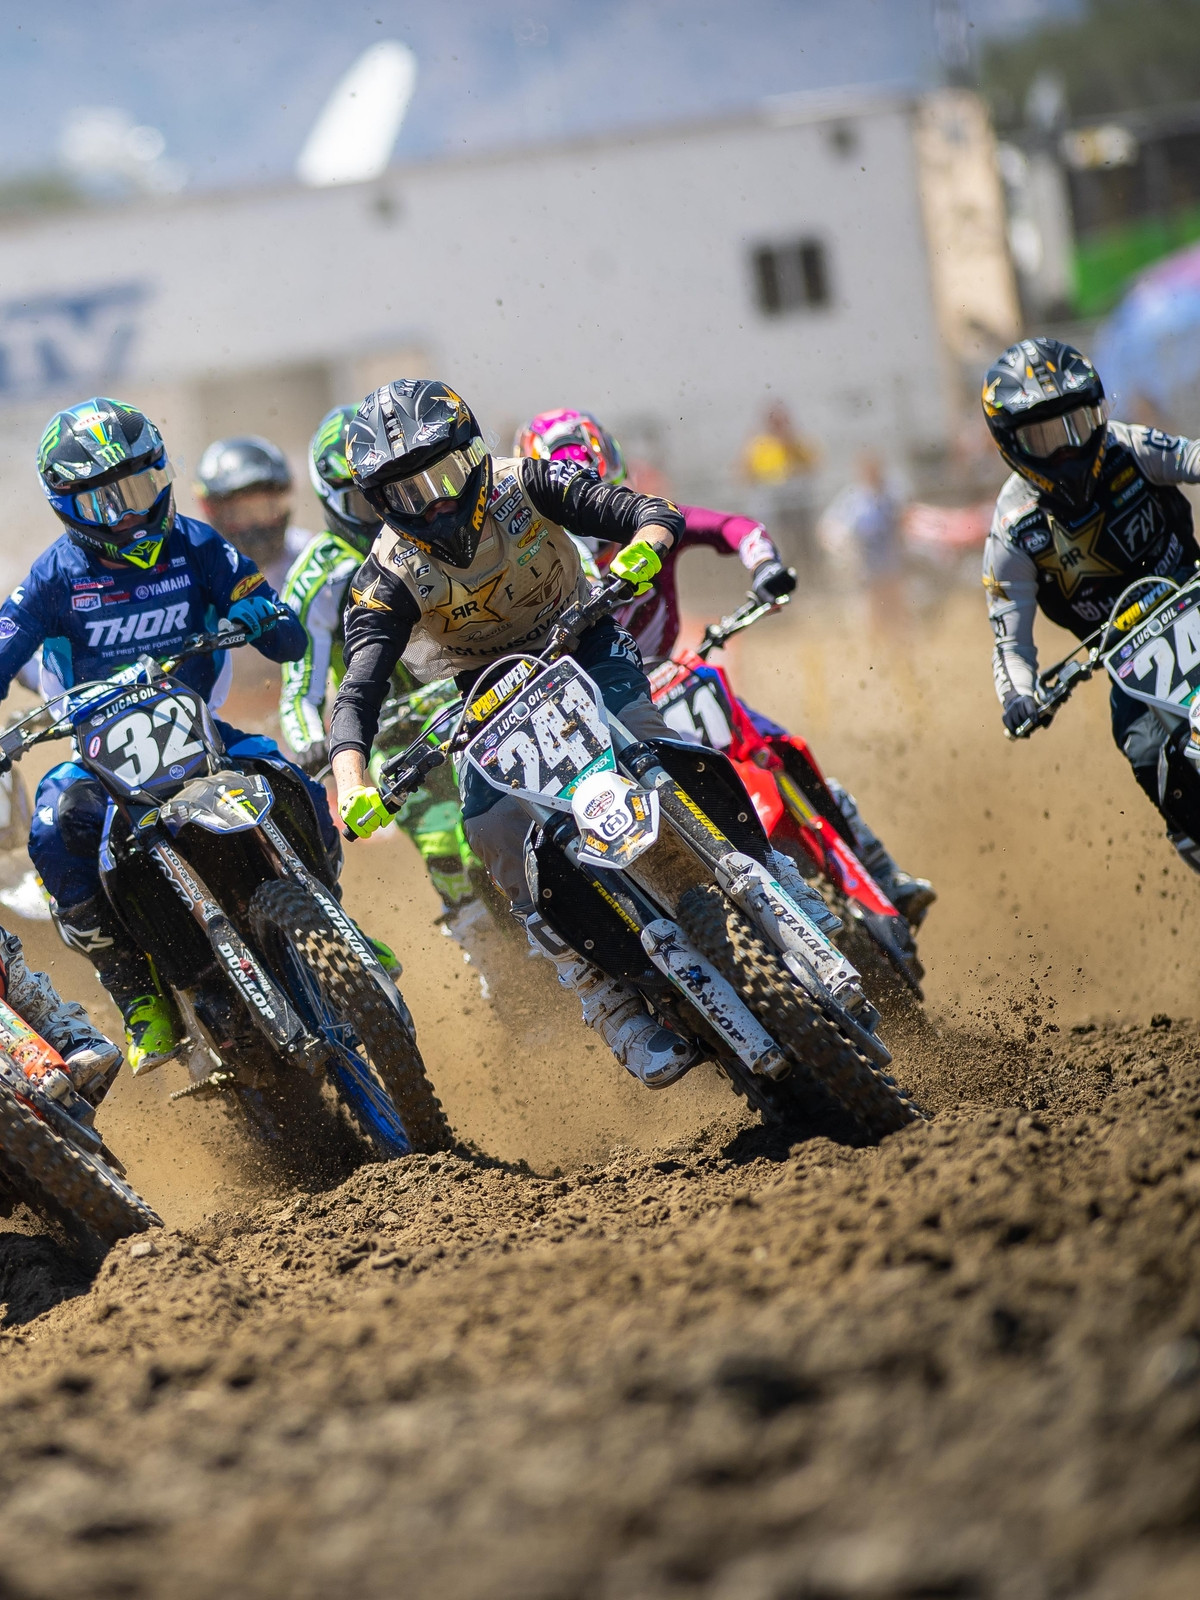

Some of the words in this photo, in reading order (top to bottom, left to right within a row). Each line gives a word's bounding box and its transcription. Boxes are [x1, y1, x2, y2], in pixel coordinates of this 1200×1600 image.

[494, 489, 523, 521] WPS
[1124, 502, 1155, 553] FLY
[75, 597, 98, 608] 100%
[148, 574, 191, 596] YAMAHA
[85, 601, 190, 647] THOR
[219, 633, 246, 646] ARC
[1161, 609, 1178, 625] OIL
[102, 651, 115, 659] THE
[116, 648, 136, 656] FIRST
[138, 645, 152, 653] THE
[152, 637, 183, 650] FOREVER
[106, 692, 140, 719] LUCAS
[139, 687, 159, 700] OIL
[471, 662, 529, 721] PROTAPER
[527, 688, 545, 706] OIL
[107, 695, 204, 788] 32
[497, 678, 610, 793] 247
[179, 866, 204, 901] racing
[313, 891, 378, 966] DUNLOP
[592, 880, 641, 934] Factory
[759, 892, 836, 963] DUNLOP
[217, 942, 276, 1020] DUNLOP
[674, 965, 747, 1044] DUNLOP
